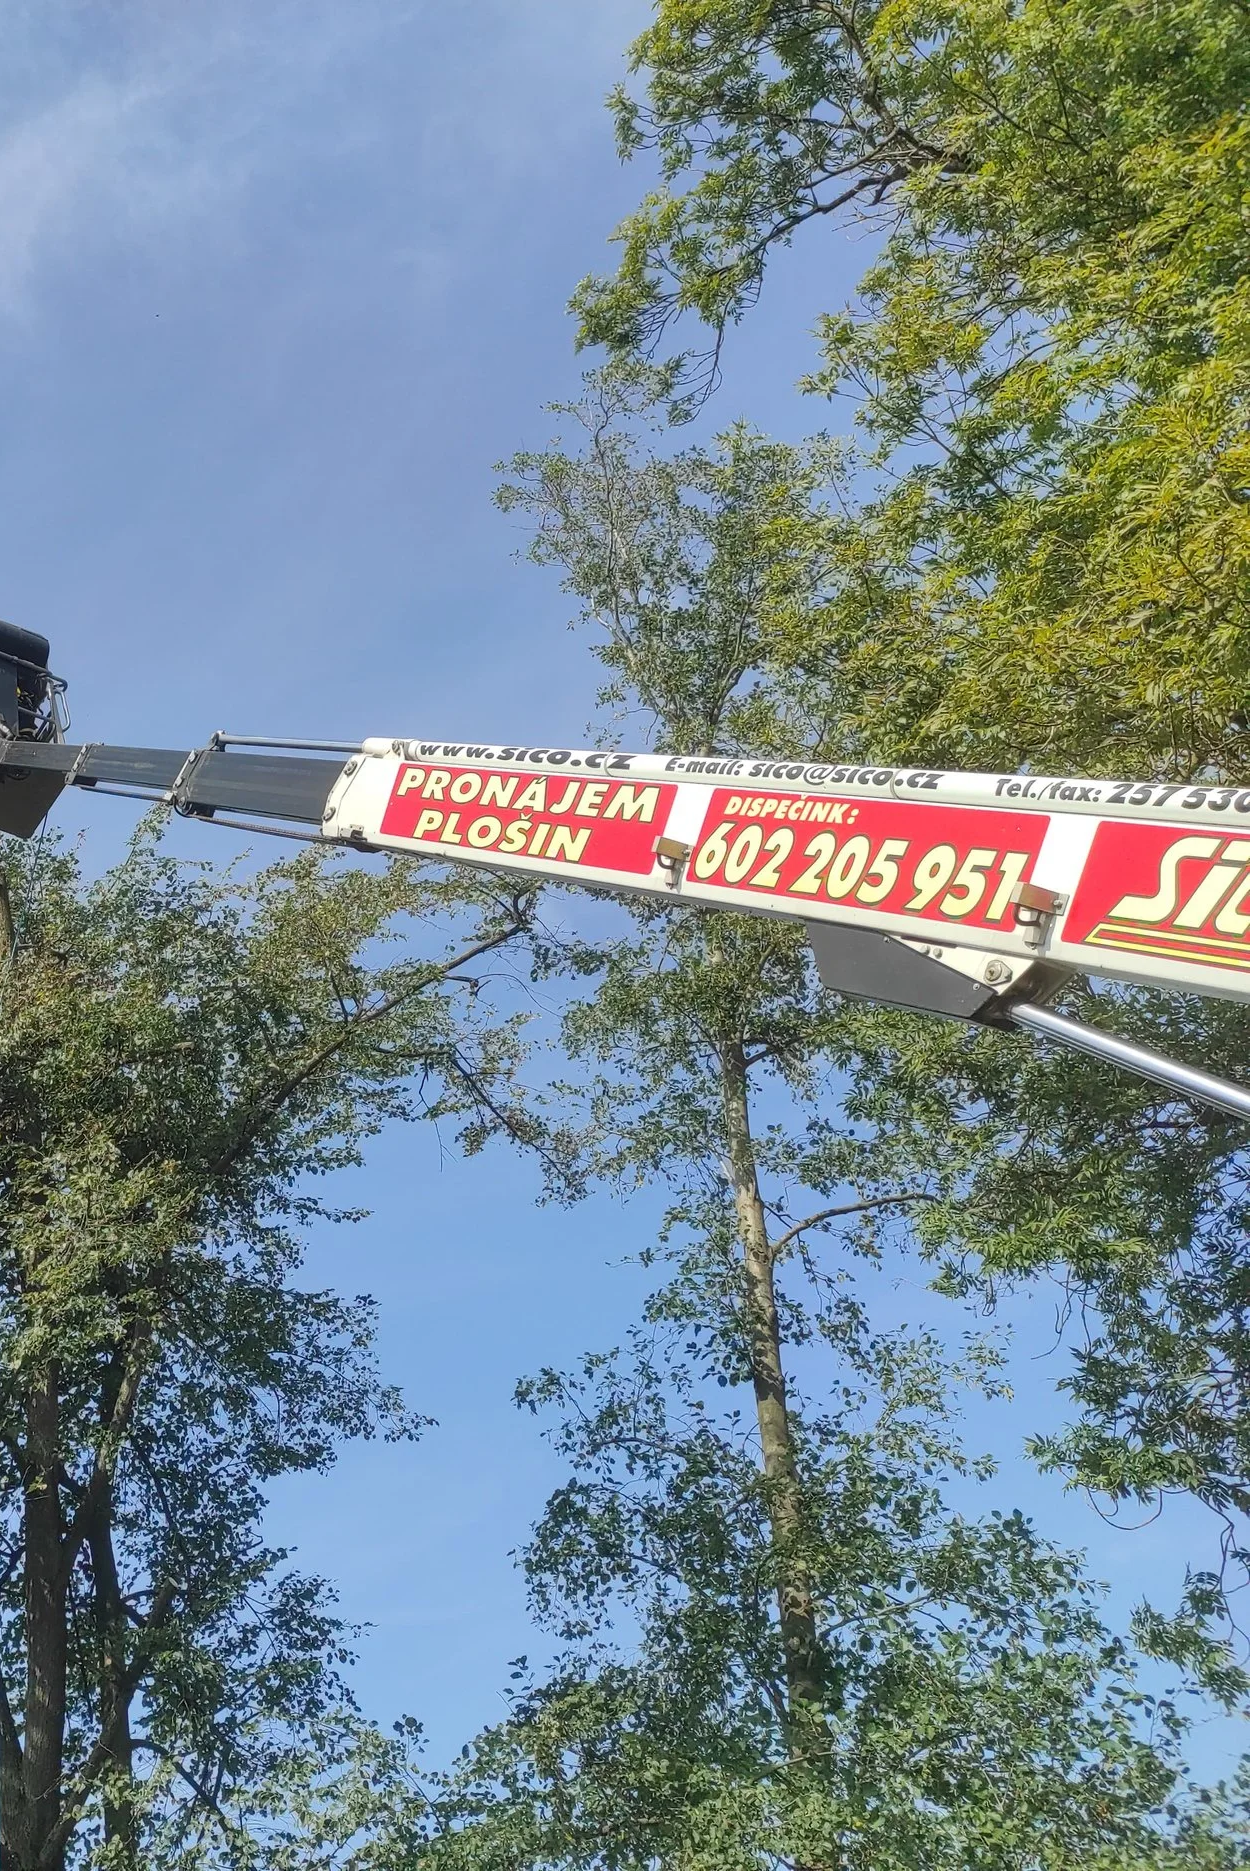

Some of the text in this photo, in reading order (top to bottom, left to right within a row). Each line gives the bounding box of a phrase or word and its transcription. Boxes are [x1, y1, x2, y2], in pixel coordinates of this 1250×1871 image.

[420, 744, 636, 769] www.sico.cz
[665, 757, 945, 790] E-mail: sico@sico.cz
[396, 767, 661, 822] PRONÁJEM
[723, 793, 859, 824] DISPEČINK:
[995, 778, 1102, 803] Tel./fax:
[1105, 783, 1186, 807] 257
[412, 806, 592, 863] PLOŠIN
[693, 821, 1029, 923] 602 205 951
